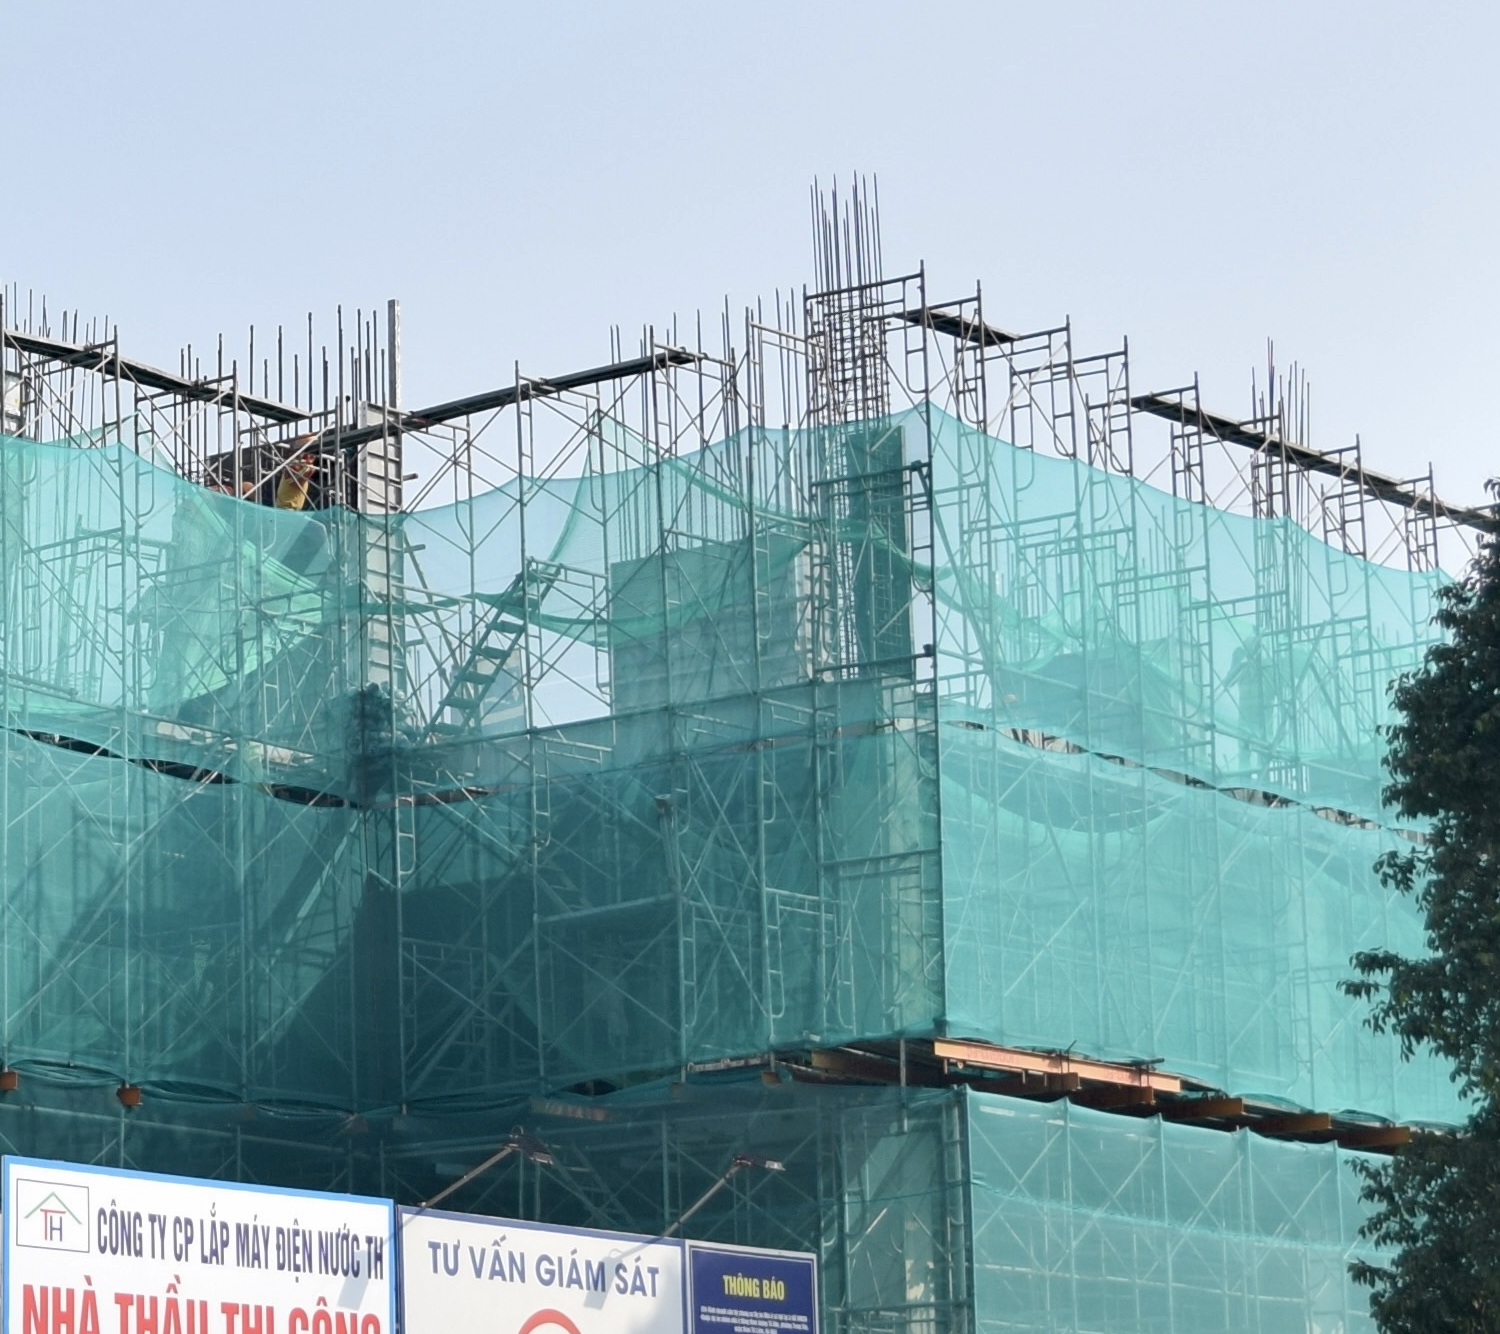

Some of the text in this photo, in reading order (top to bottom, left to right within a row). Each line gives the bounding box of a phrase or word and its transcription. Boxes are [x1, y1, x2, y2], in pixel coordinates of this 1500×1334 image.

[40, 1208, 67, 1242] TH
[97, 1198, 384, 1283] CÔNG TY CP LẮP MÁY ĐIỆN NƯỚC TH
[426, 1238, 659, 1297] TƯ VẤN GIÁM SÁT
[723, 1272, 785, 1301] THÔNG BÁO
